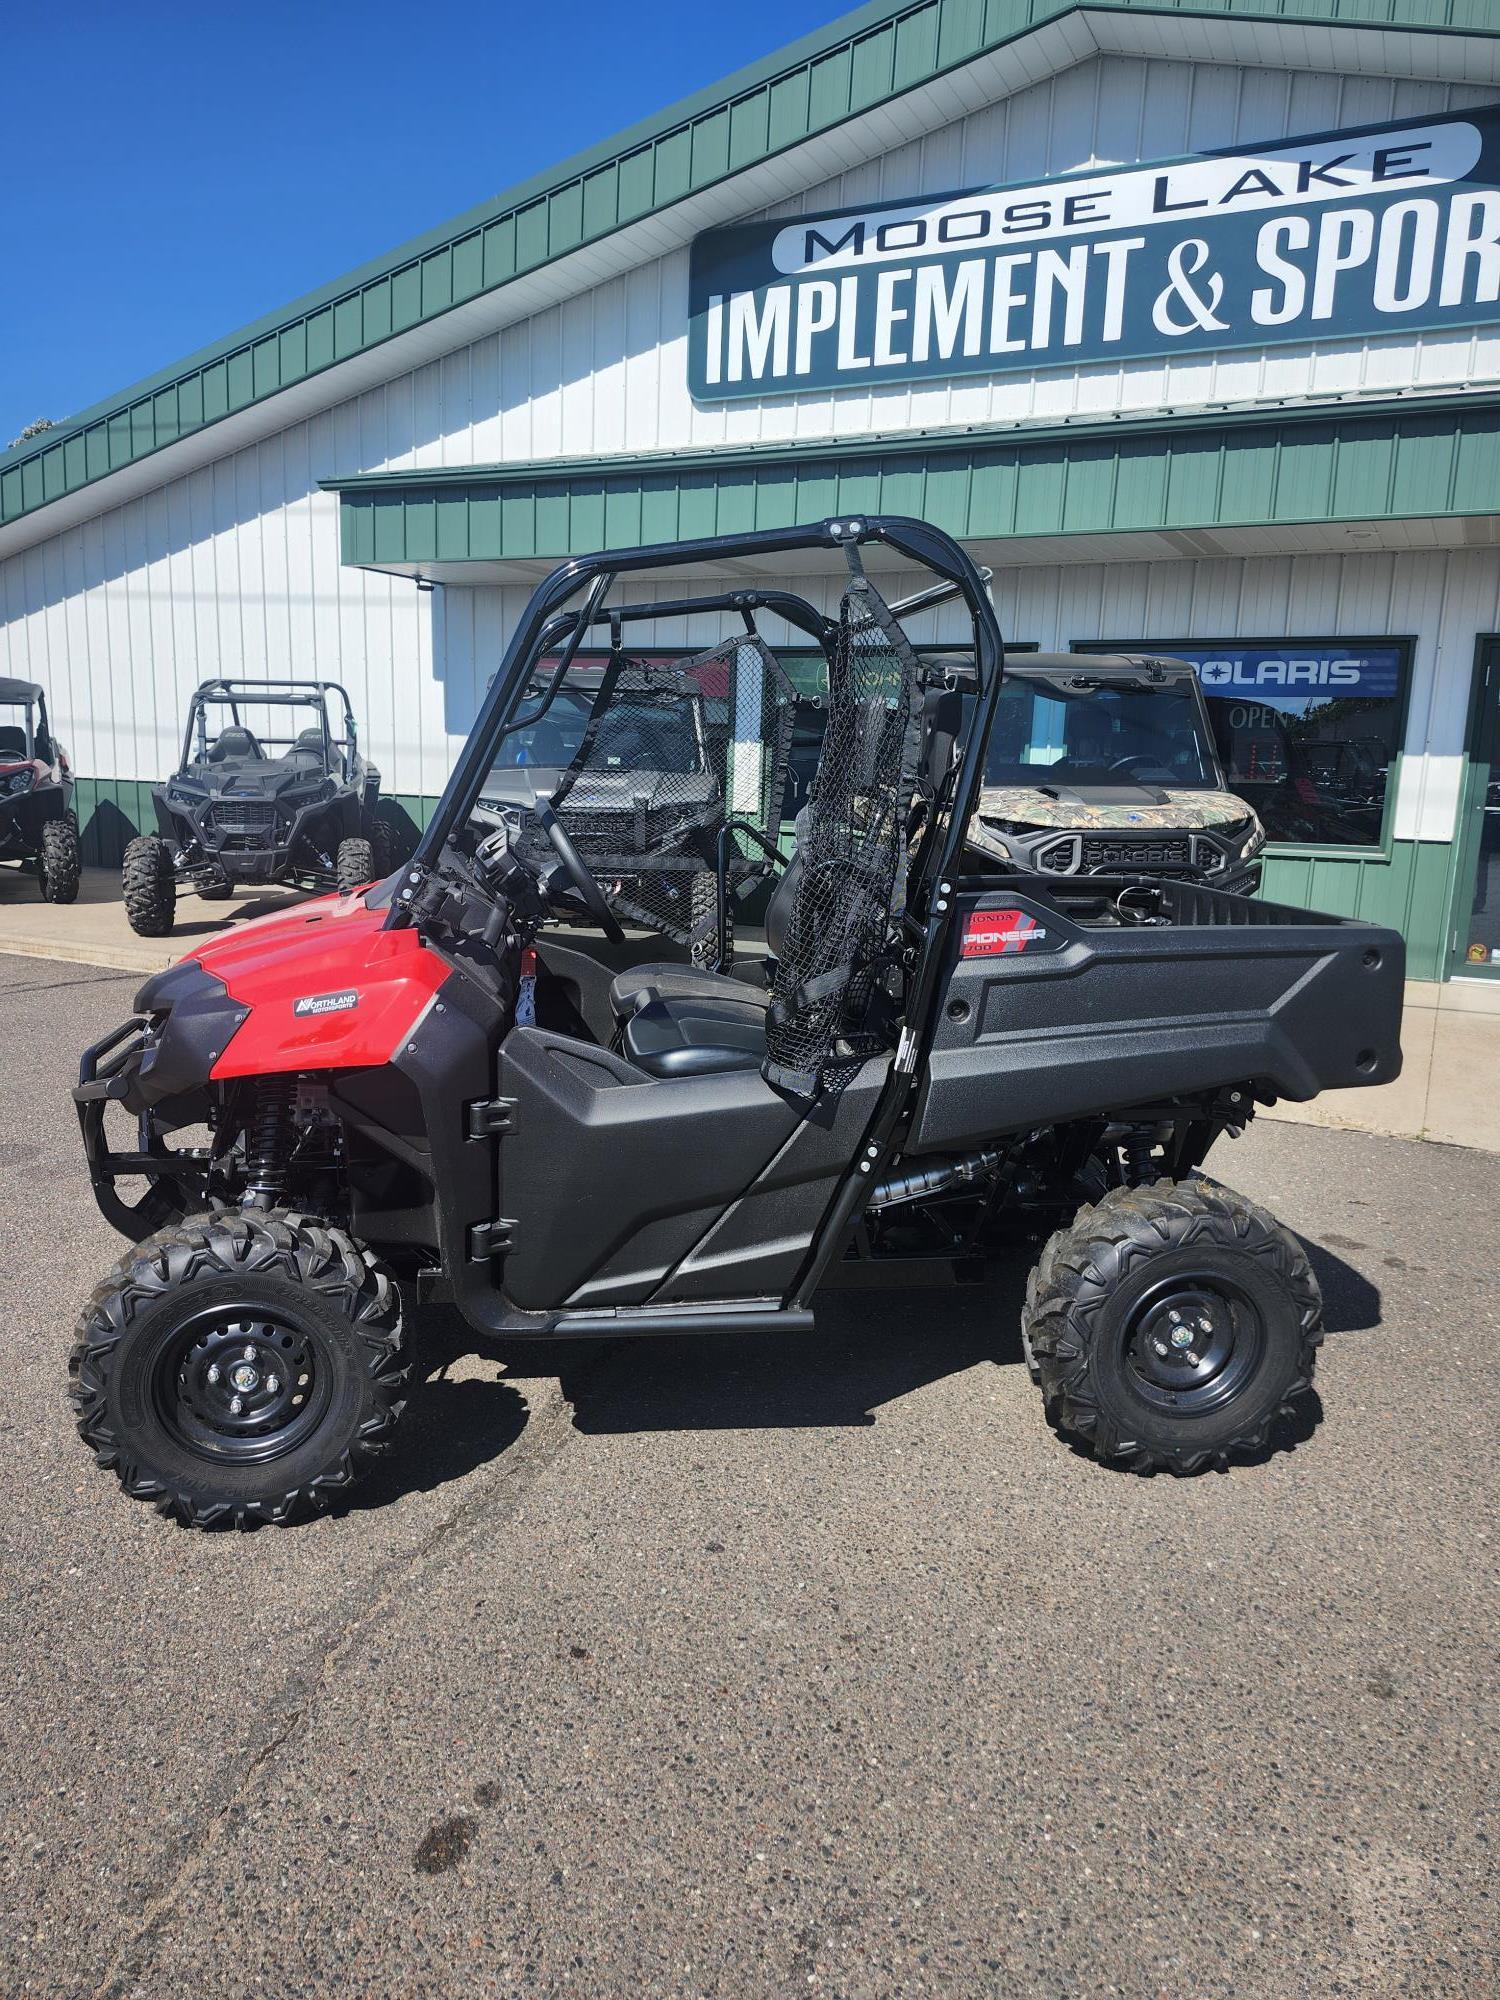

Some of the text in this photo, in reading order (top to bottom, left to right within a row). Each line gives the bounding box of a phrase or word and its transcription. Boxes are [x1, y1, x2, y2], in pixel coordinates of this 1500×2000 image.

[804, 141, 1433, 264] MOOSE LAKE
[705, 237, 1145, 385] IMPLEMENT
[1151, 238, 1230, 338] &
[1229, 706, 1288, 730] OPEN
[969, 914, 1014, 923] HONDA
[963, 928, 1046, 945] PIONEER
[296, 995, 356, 1013] NORTHLAND
